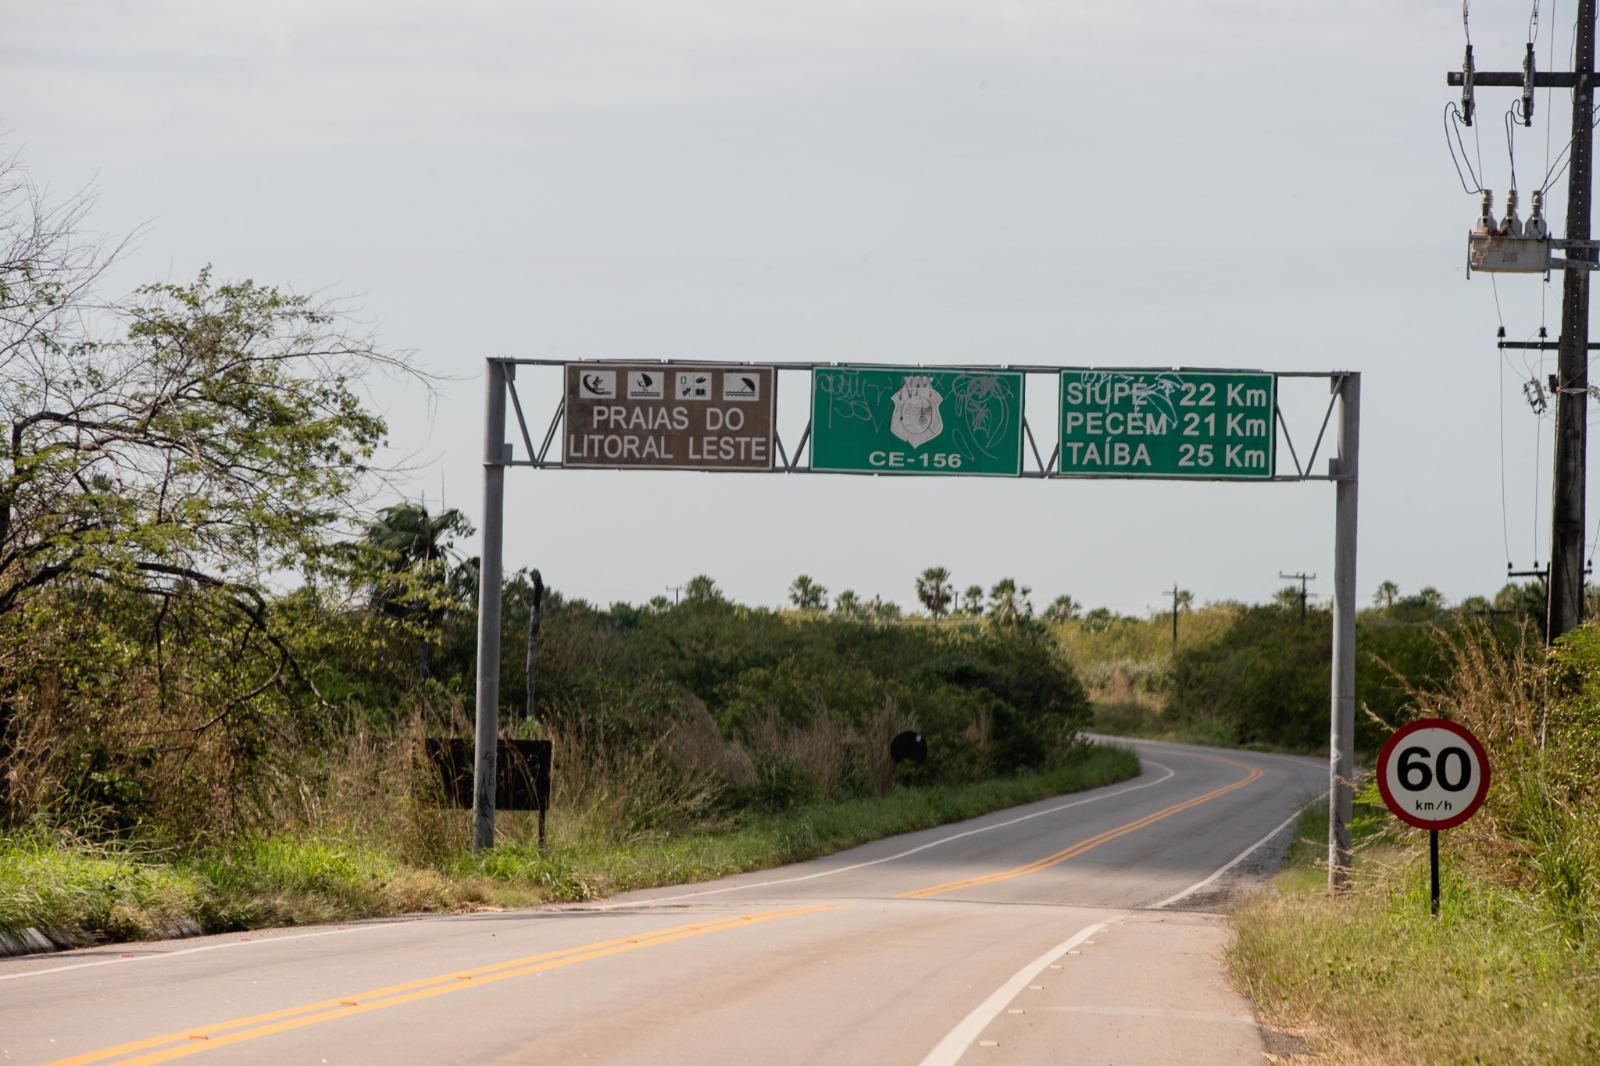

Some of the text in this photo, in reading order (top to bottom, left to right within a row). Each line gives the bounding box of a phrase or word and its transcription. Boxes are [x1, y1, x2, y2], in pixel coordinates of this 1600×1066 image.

[1066, 376, 1148, 406] SIUPÉ
[1179, 385, 1216, 406] 22
[1226, 383, 1267, 407] Km
[592, 406, 745, 431] PRAIAS DO
[1066, 406, 1266, 437] PECÉM 21 Km
[569, 434, 767, 461] LITORAL LESTE
[868, 451, 962, 468] CE-156
[1066, 436, 1265, 468] TAÍBA 25 Km
[1397, 746, 1472, 792] 60
[1415, 800, 1452, 811] km/h
